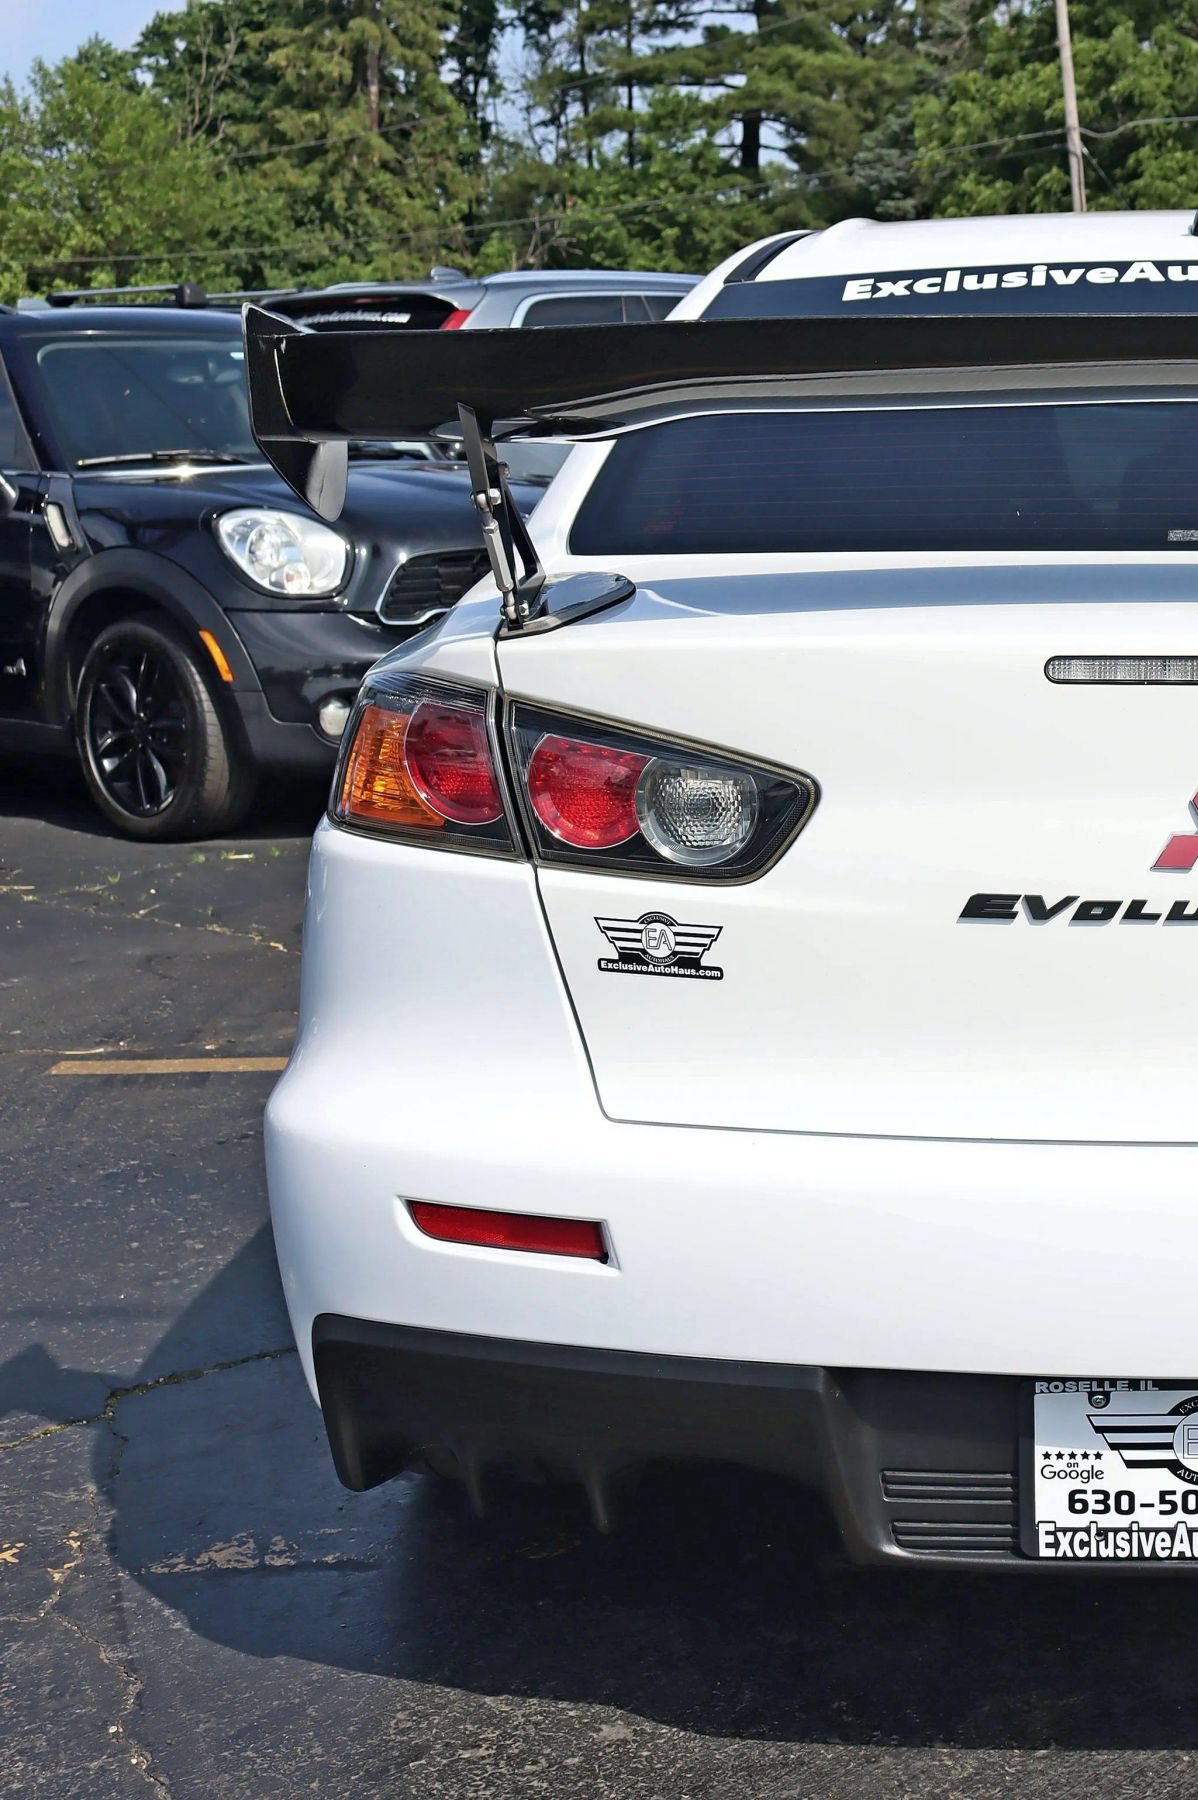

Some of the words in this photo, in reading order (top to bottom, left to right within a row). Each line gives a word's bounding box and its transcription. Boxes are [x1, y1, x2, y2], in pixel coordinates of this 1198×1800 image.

[645, 928, 673, 951] EA
[600, 960, 721, 977] ExclusiveAutoHaus.com
[1140, 1380, 1159, 1391] IL
[1066, 1461, 1079, 1469] on
[1040, 1464, 1105, 1485] Google
